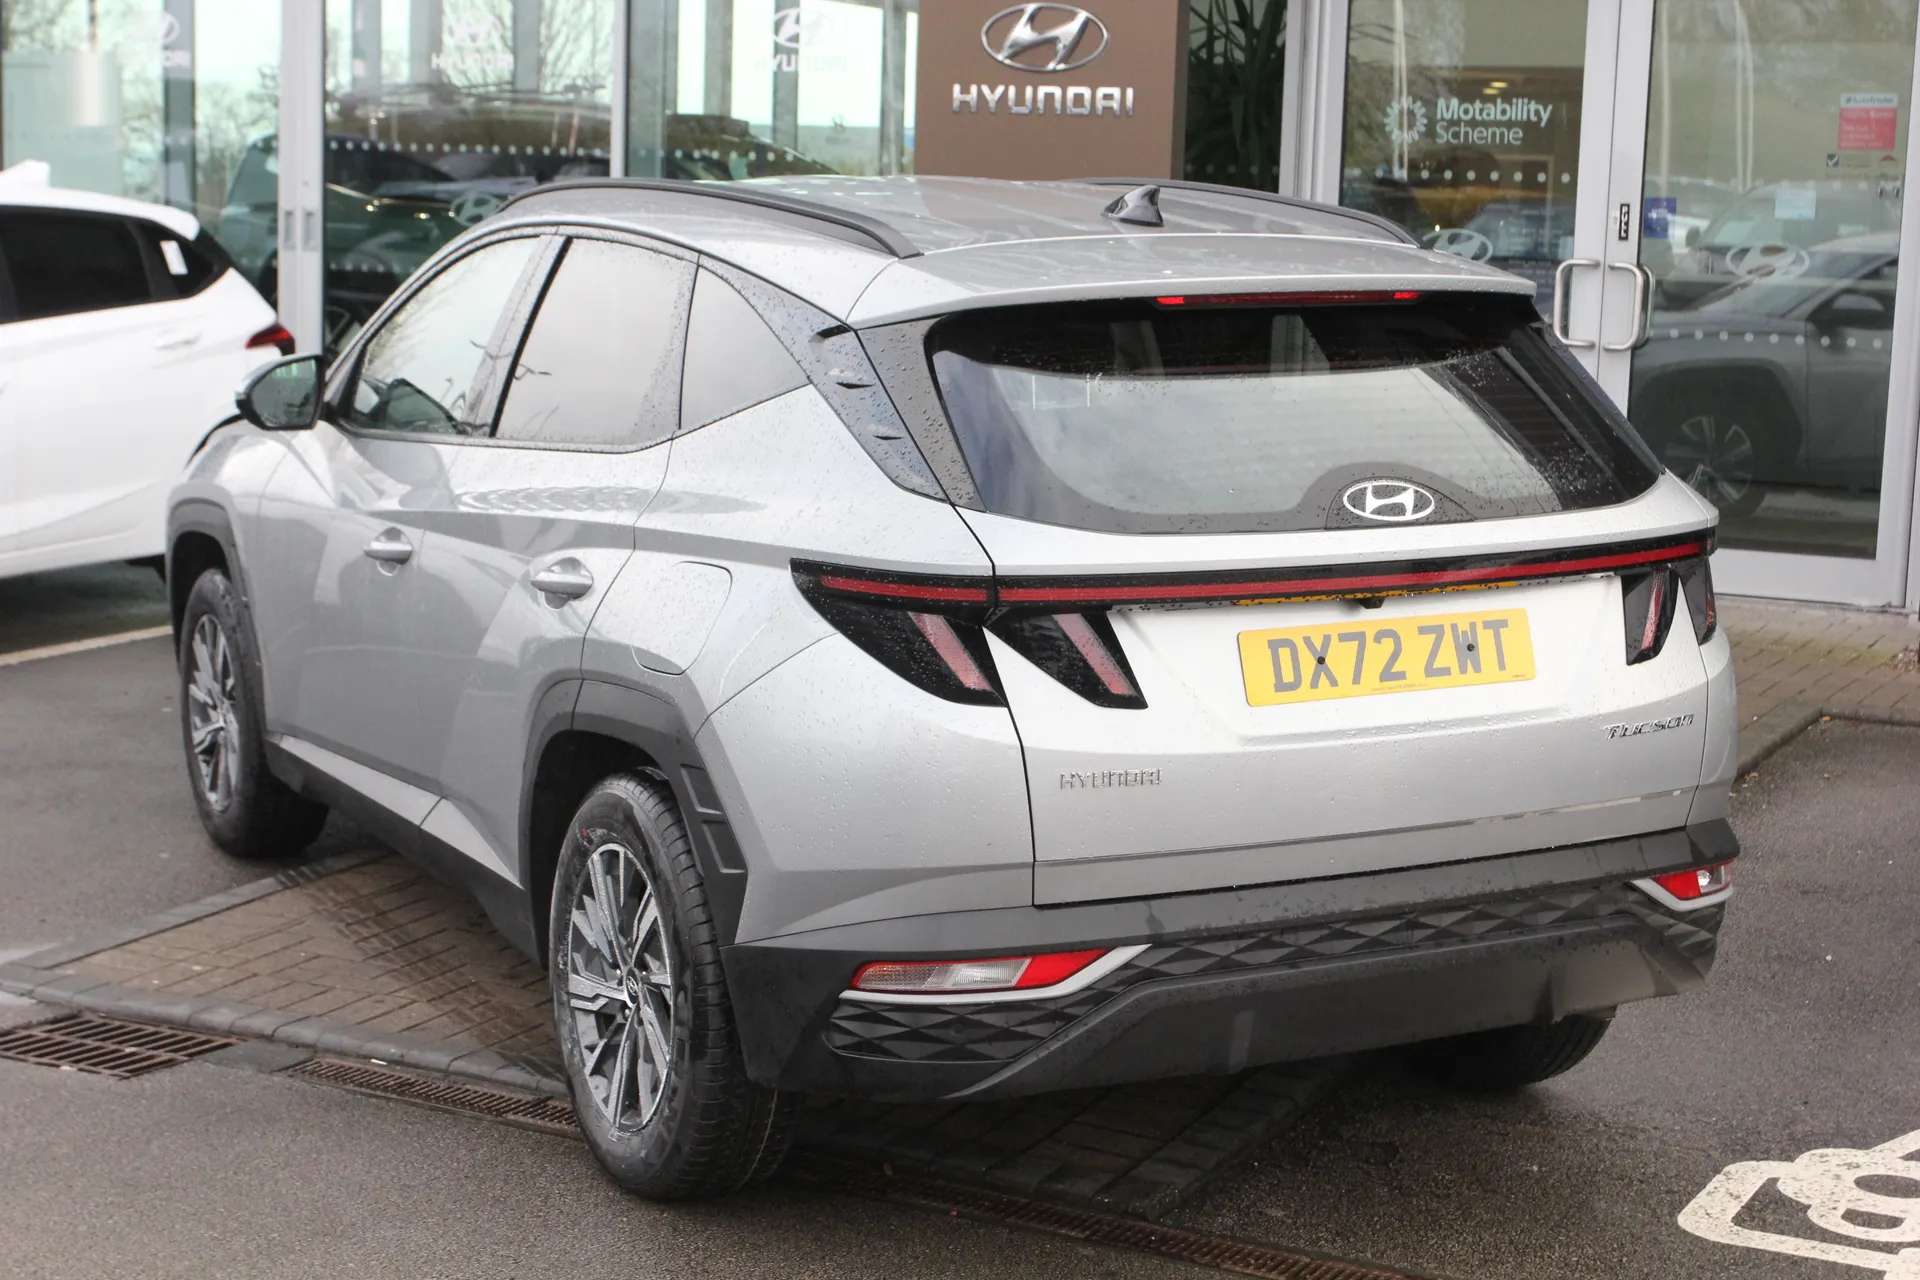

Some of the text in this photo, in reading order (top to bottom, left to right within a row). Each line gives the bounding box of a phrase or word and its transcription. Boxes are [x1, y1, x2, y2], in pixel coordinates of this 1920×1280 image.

[952, 83, 1135, 116] HYUNDAI
[1436, 96, 1552, 127] Motability
[1435, 122, 1523, 145] Scheme
[1267, 619, 1509, 693] DX72 ZWT
[1603, 713, 1695, 741] TUCSON
[1060, 768, 1162, 791] HYUNDAI
